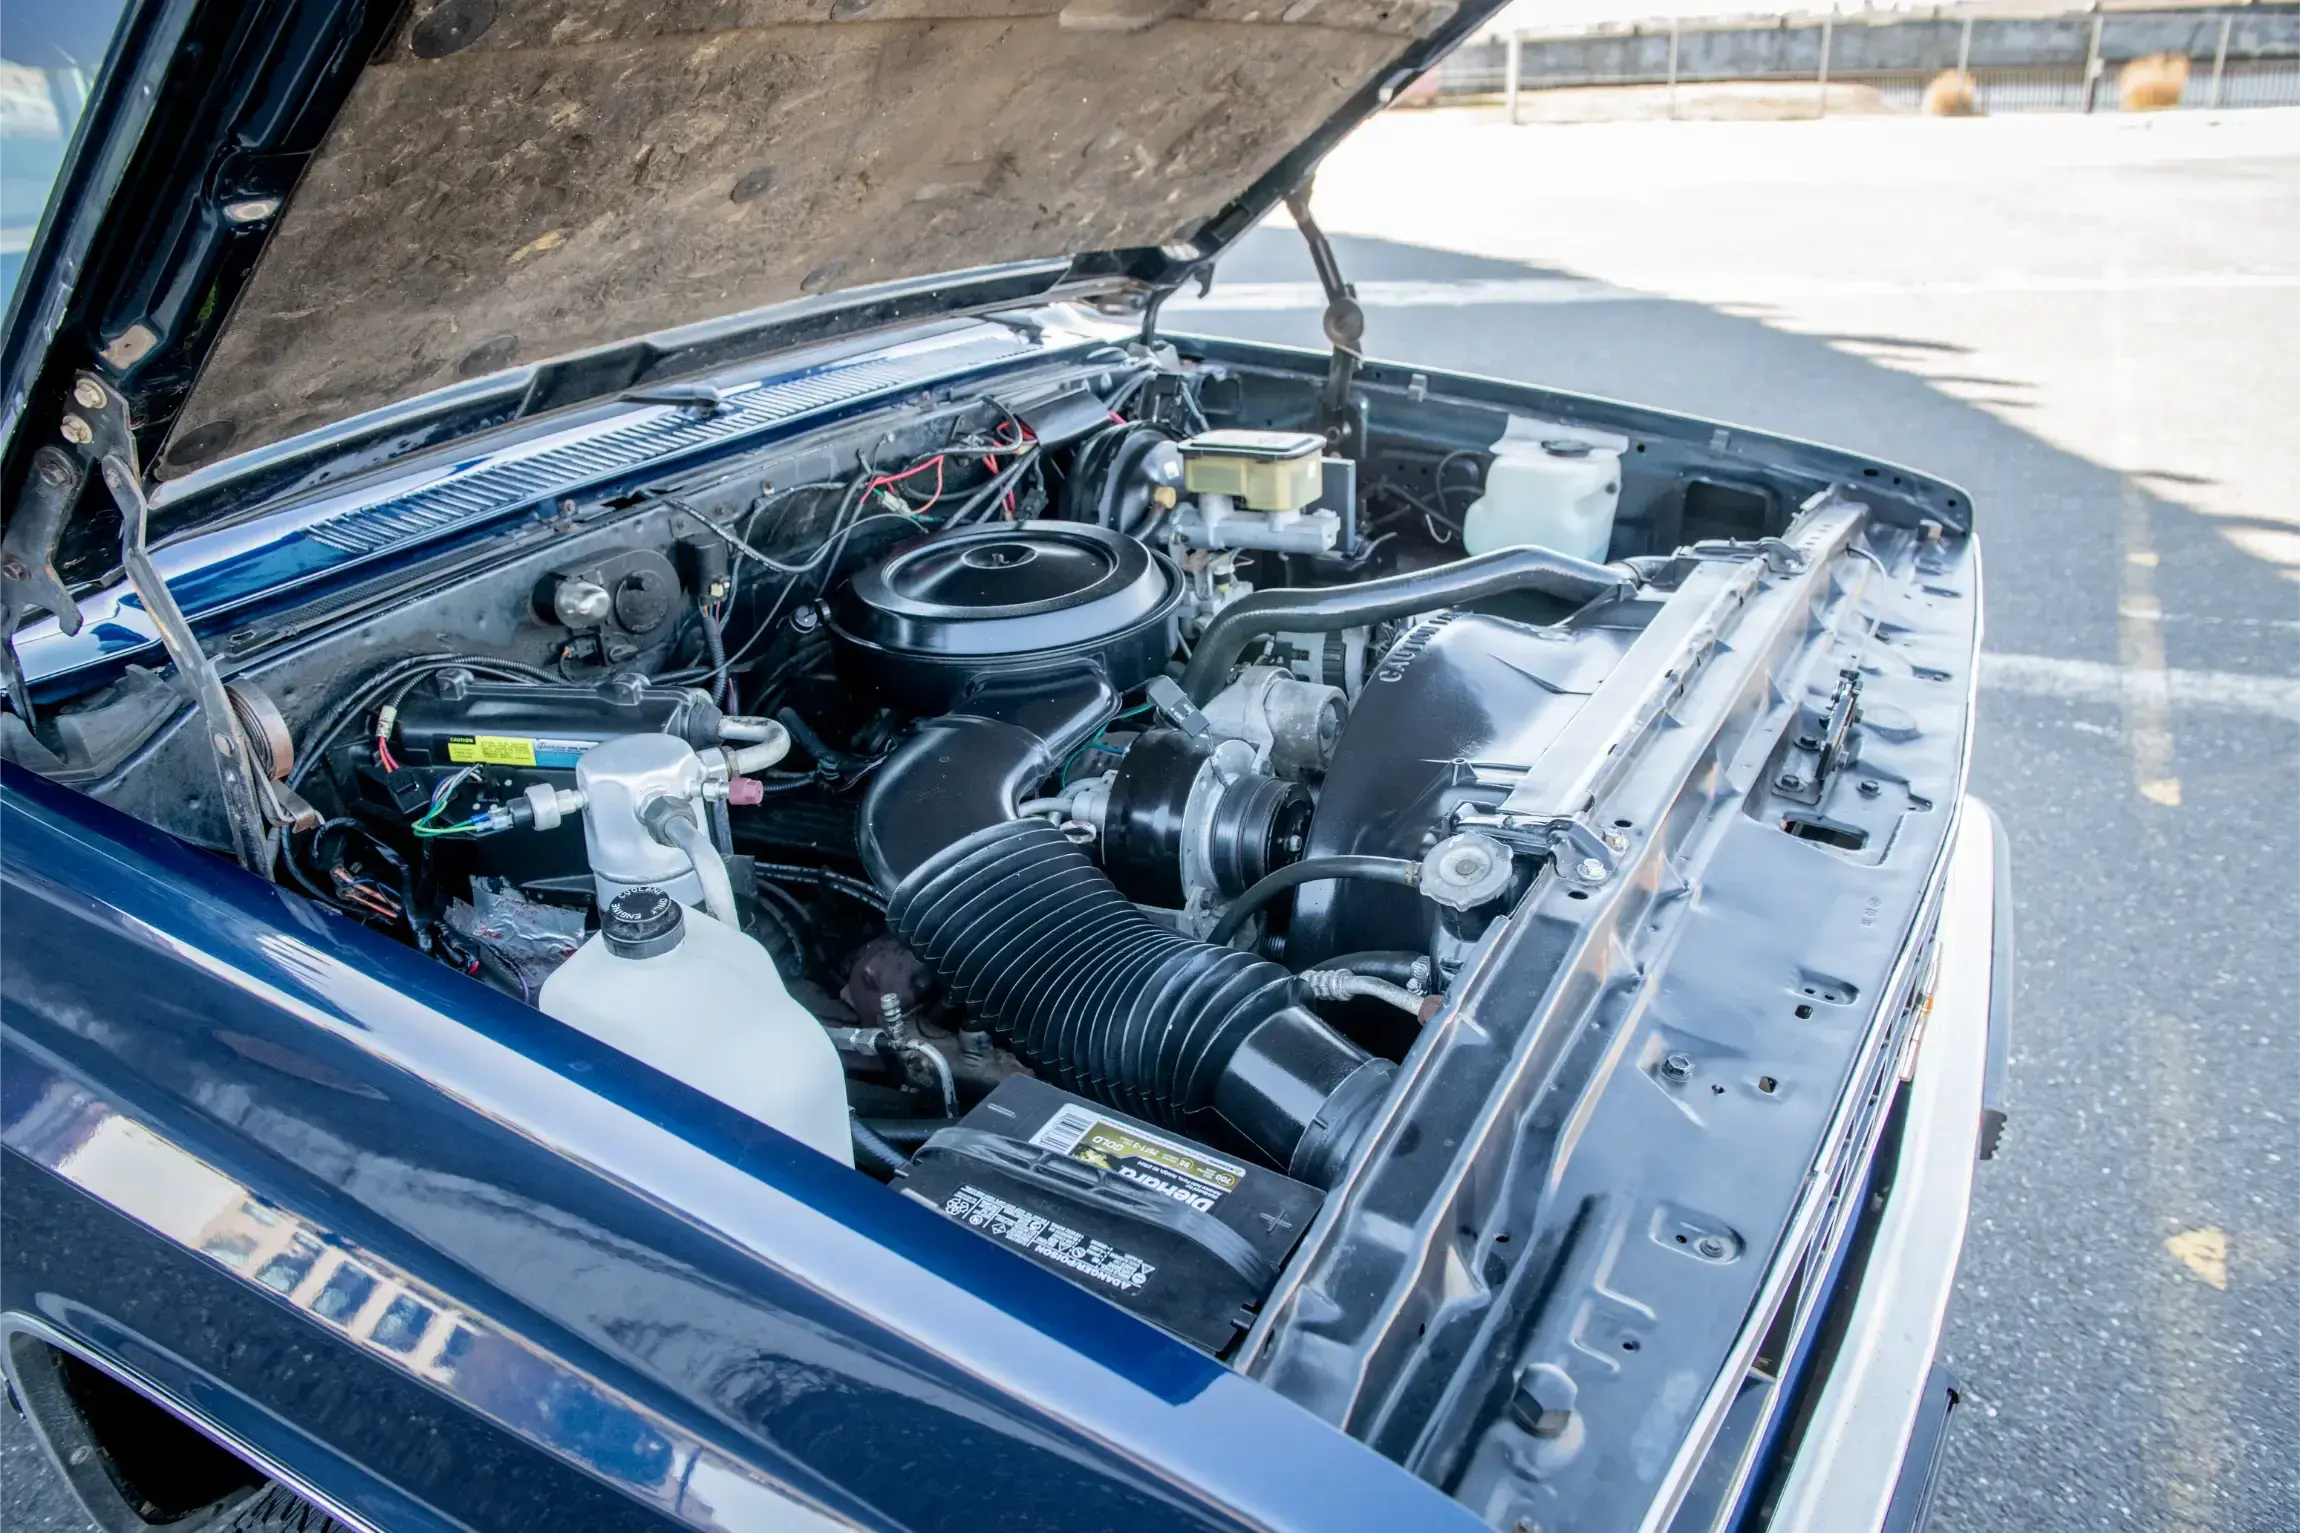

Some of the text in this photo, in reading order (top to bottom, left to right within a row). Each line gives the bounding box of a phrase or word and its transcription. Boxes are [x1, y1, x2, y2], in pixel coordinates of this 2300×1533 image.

[611, 886, 668, 919] ENGINE COOLANT ONLY
[1092, 1135, 1125, 1151] GOLD
[1215, 1174, 1232, 1184] 700
[1034, 1243, 1122, 1286] DANGER/POISON
